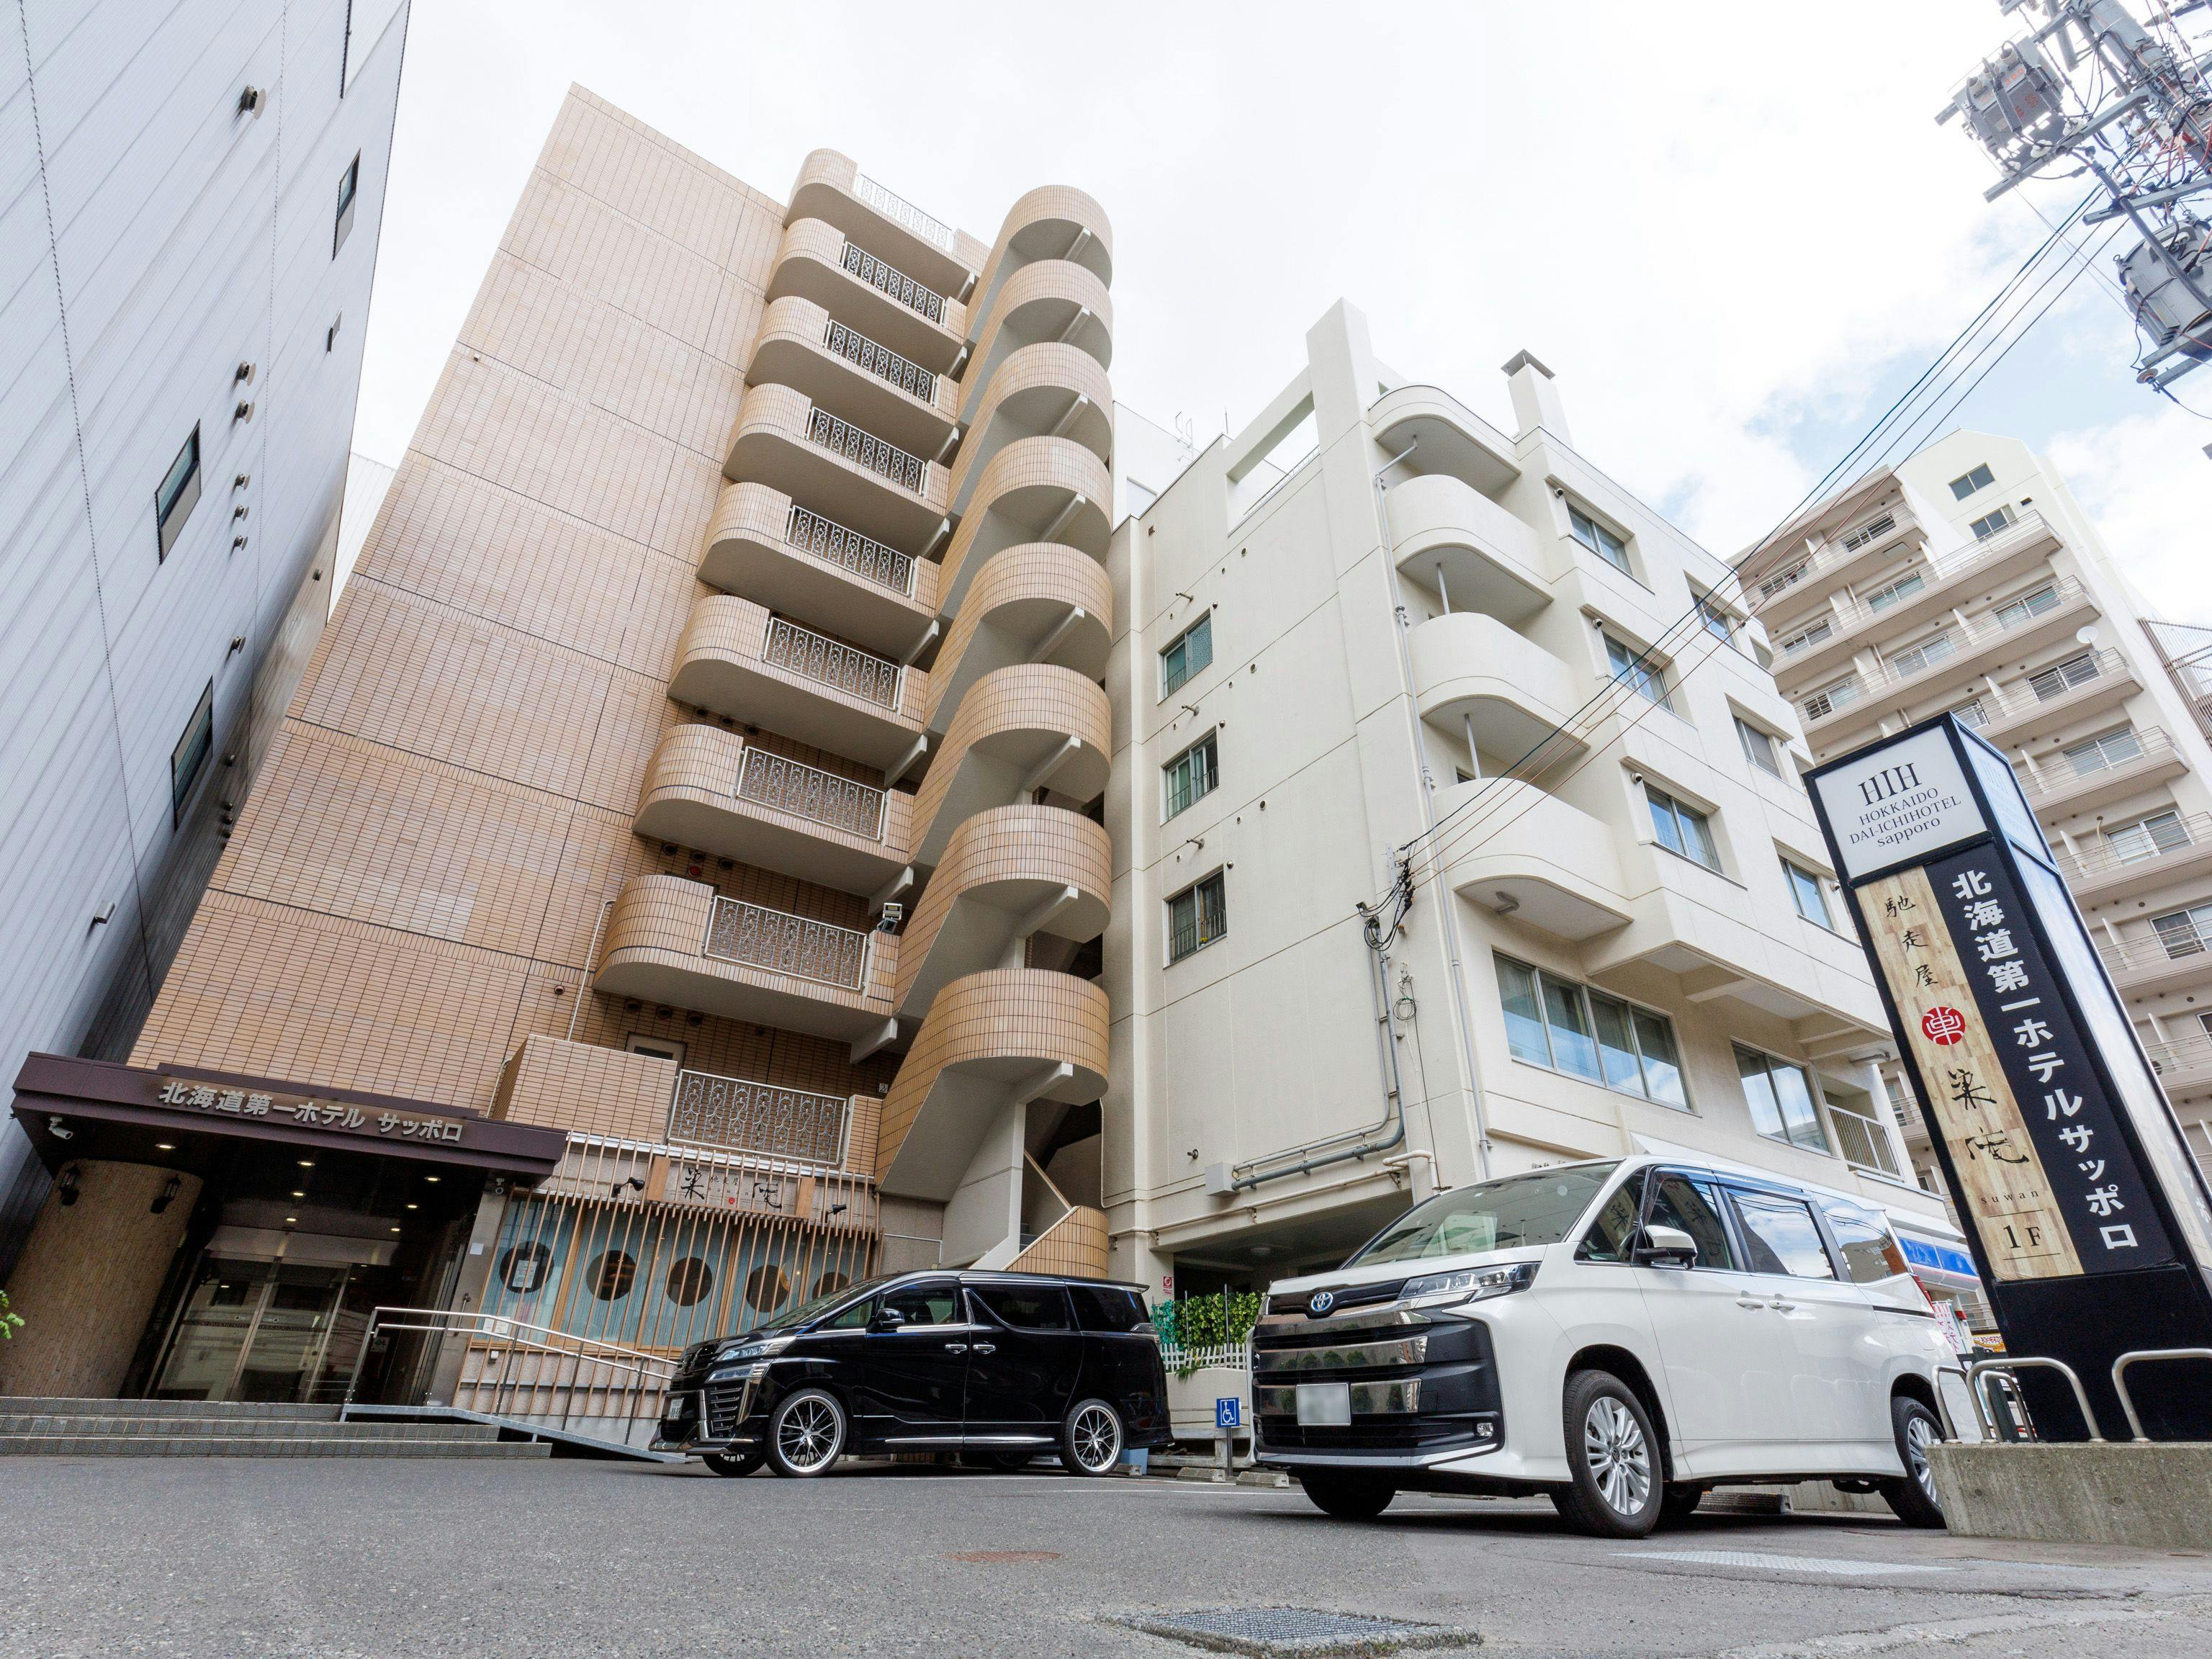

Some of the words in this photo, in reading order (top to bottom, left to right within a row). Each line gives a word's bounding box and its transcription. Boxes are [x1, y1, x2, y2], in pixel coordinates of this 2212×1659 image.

[1858, 763, 1923, 806] HIH
[1859, 788, 1938, 825] HOKKAIDO
[1877, 818, 1941, 848] sapporo
[1884, 895, 1939, 988] 馳走屋
[1952, 869, 2138, 1249] 北海道第一ホテルサッポロ
[158, 1082, 366, 1129] 北海道第一ホテル
[377, 1112, 463, 1142] サッポロ
[1981, 1190, 2039, 1204] suwan
[2003, 1225, 2041, 1249] 1F
